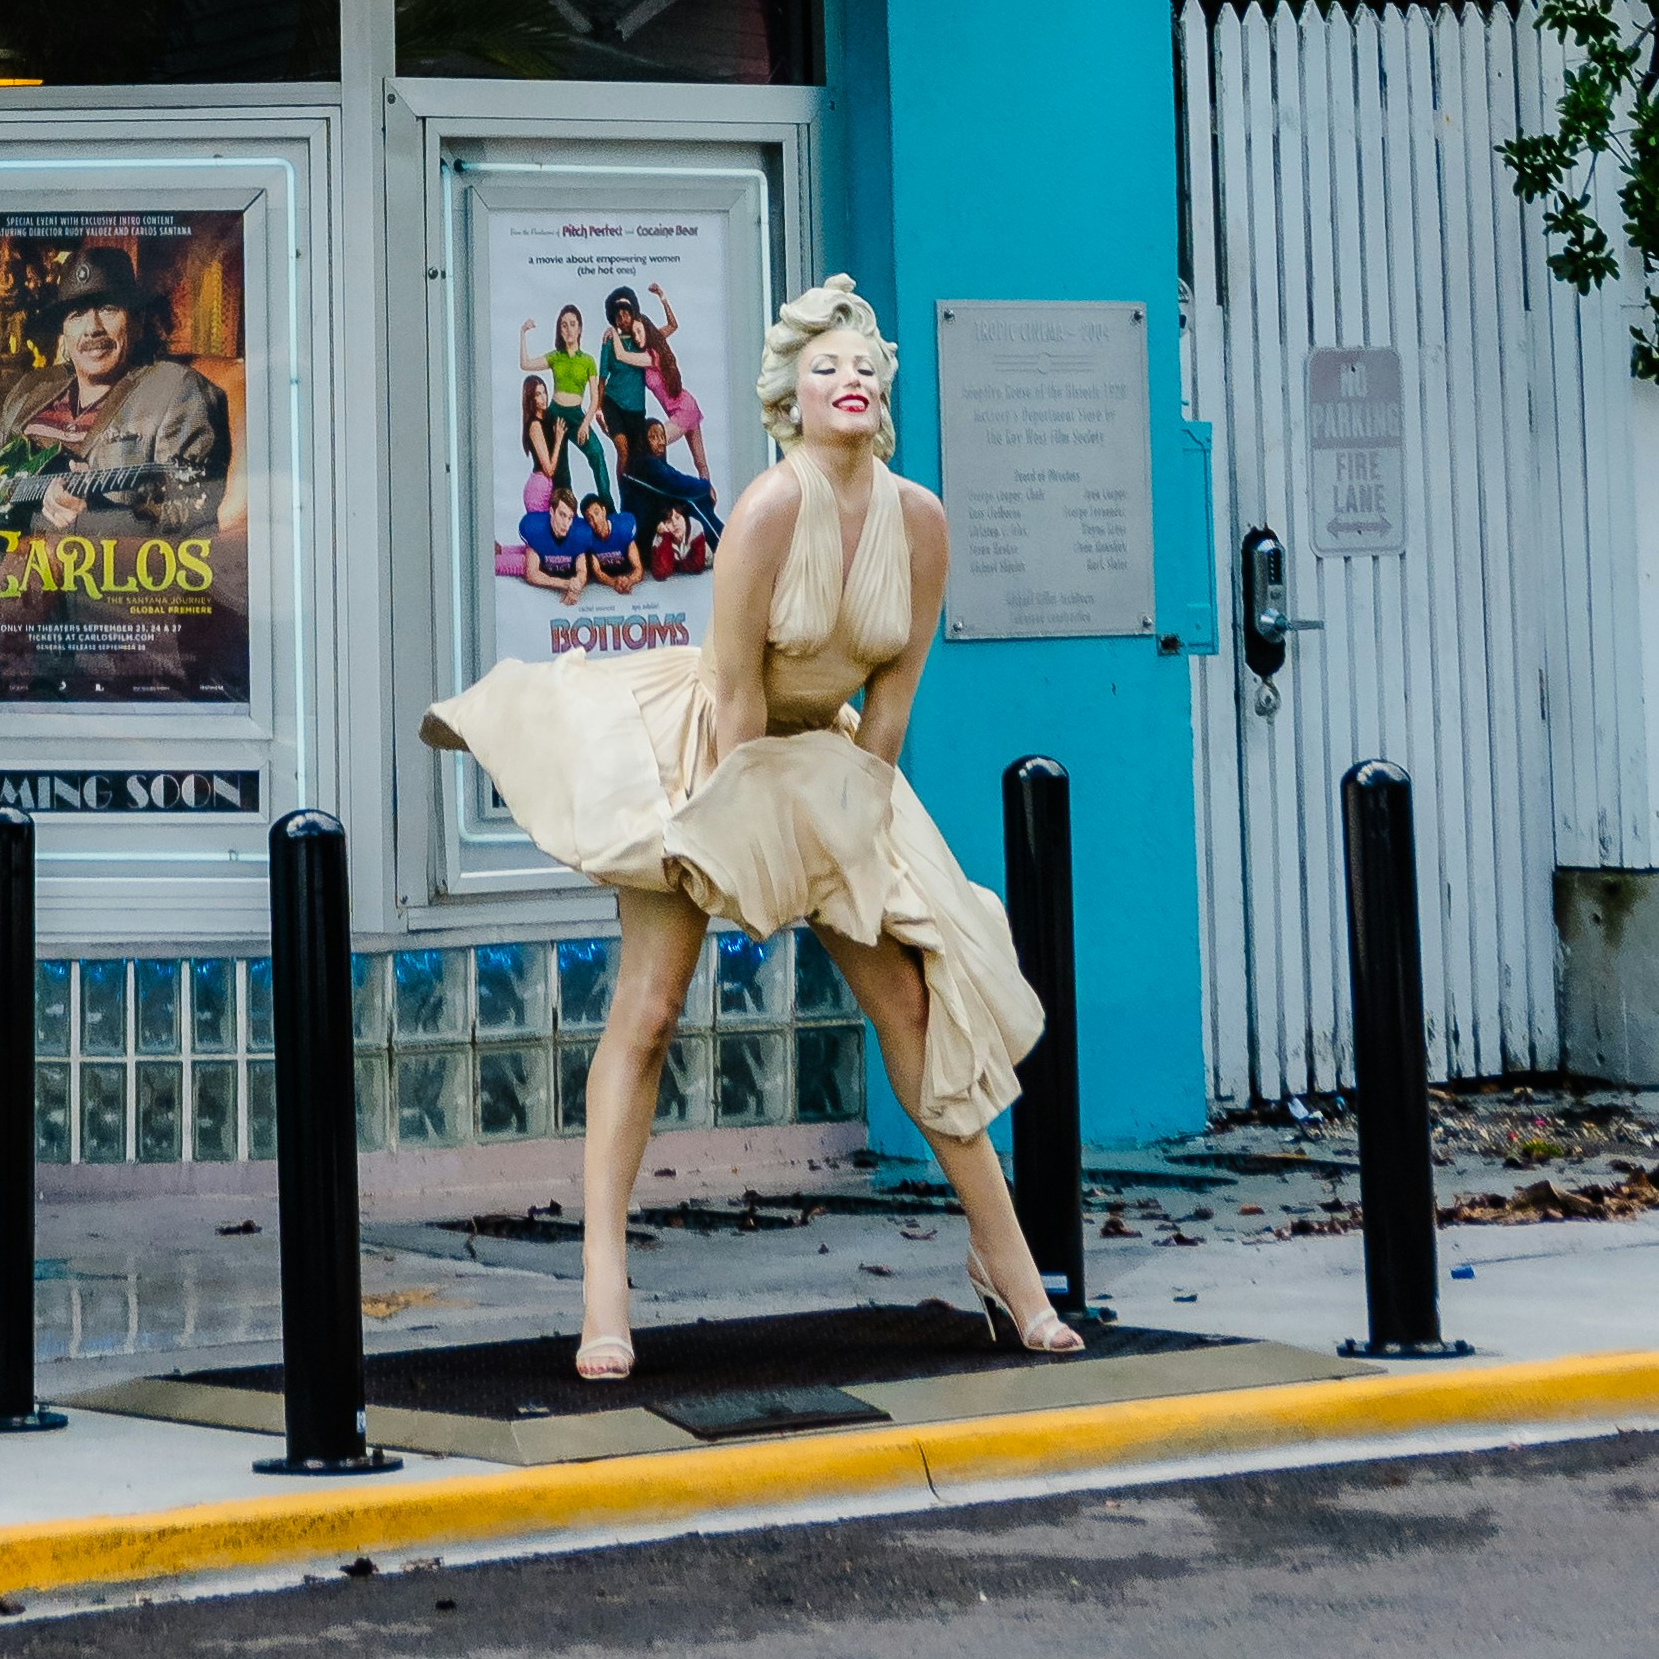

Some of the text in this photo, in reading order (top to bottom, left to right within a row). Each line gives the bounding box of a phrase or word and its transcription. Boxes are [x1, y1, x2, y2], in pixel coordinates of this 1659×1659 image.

[6, 216, 174, 227] SPECIAL EVENT WITH EXCLUSIVE INTRO CONTENT
[29, 228, 64, 237] DIRECTOR
[115, 227, 129, 236] AND
[131, 227, 158, 236] CARLOS
[159, 226, 192, 236] SANTANA
[562, 224, 588, 239] Pitch
[589, 225, 623, 237] Perfect
[636, 225, 675, 239] Cocaine
[676, 225, 699, 236] Bear
[536, 255, 564, 264] movie
[566, 254, 594, 264] about
[596, 254, 647, 265] empowering
[649, 255, 681, 263] women
[577, 266, 637, 276] (the hot ones)
[974, 320, 1015, 342] TROPIC
[1340, 362, 1368, 397] NO
[1312, 401, 1401, 438] PARKING
[1335, 451, 1381, 481] FIRE
[1333, 484, 1386, 513] LANE
[107, 596, 212, 604] THE SANTANA JOURNEY
[130, 606, 213, 614] GLOBAL PREMIERE
[0, 624, 24, 632] ONLY
[25, 624, 35, 632] IN
[36, 624, 81, 633] THEATERS
[83, 624, 134, 633] SEPTEMBER
[550, 612, 690, 654] BOTTOMS
[28, 634, 155, 642] TICKETS AT CARLOSFILM.COM
[127, 773, 242, 809] SOON
